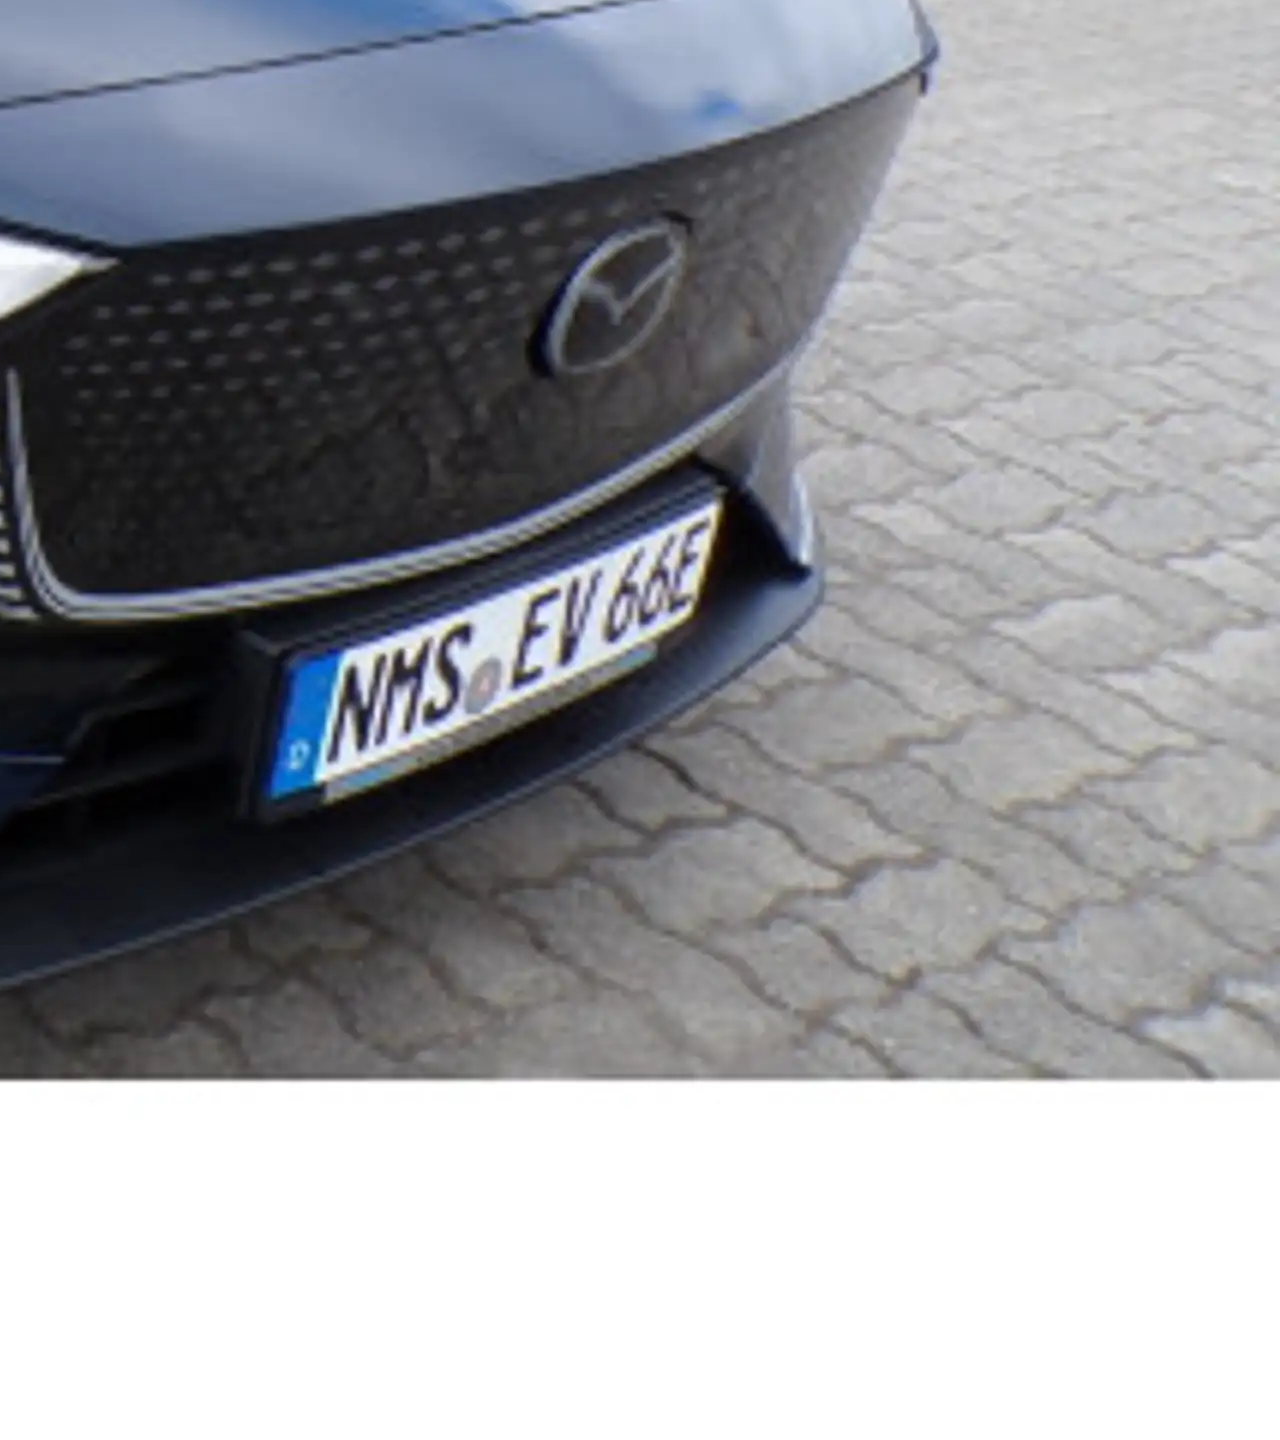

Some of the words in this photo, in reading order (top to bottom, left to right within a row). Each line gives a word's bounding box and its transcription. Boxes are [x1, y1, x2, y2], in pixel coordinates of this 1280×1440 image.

[326, 623, 472, 764] NMS
[512, 570, 603, 688] EV
[603, 522, 712, 645] 66E
